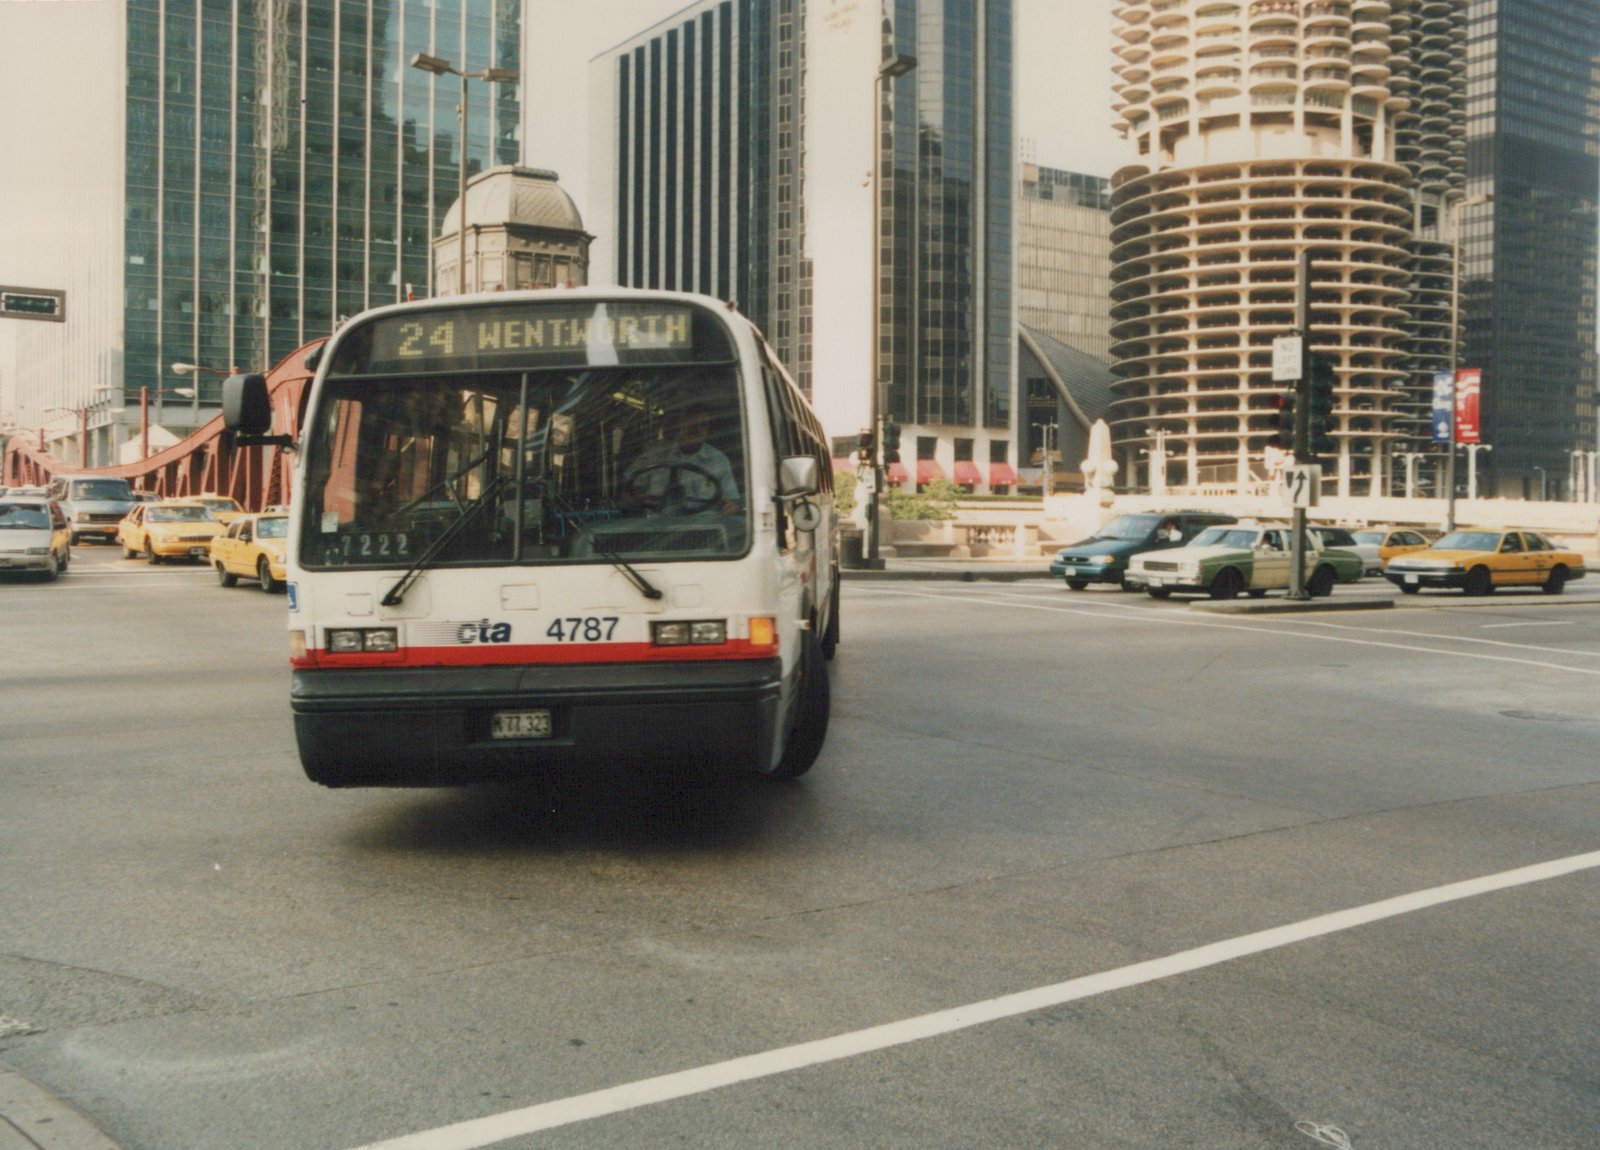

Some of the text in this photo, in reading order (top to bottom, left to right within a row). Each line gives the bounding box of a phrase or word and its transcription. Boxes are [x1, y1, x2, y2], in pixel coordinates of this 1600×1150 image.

[399, 313, 687, 356] 24 WENTWORTH
[341, 533, 409, 557] 7222
[456, 618, 512, 644] cta
[546, 616, 619, 642] 4787
